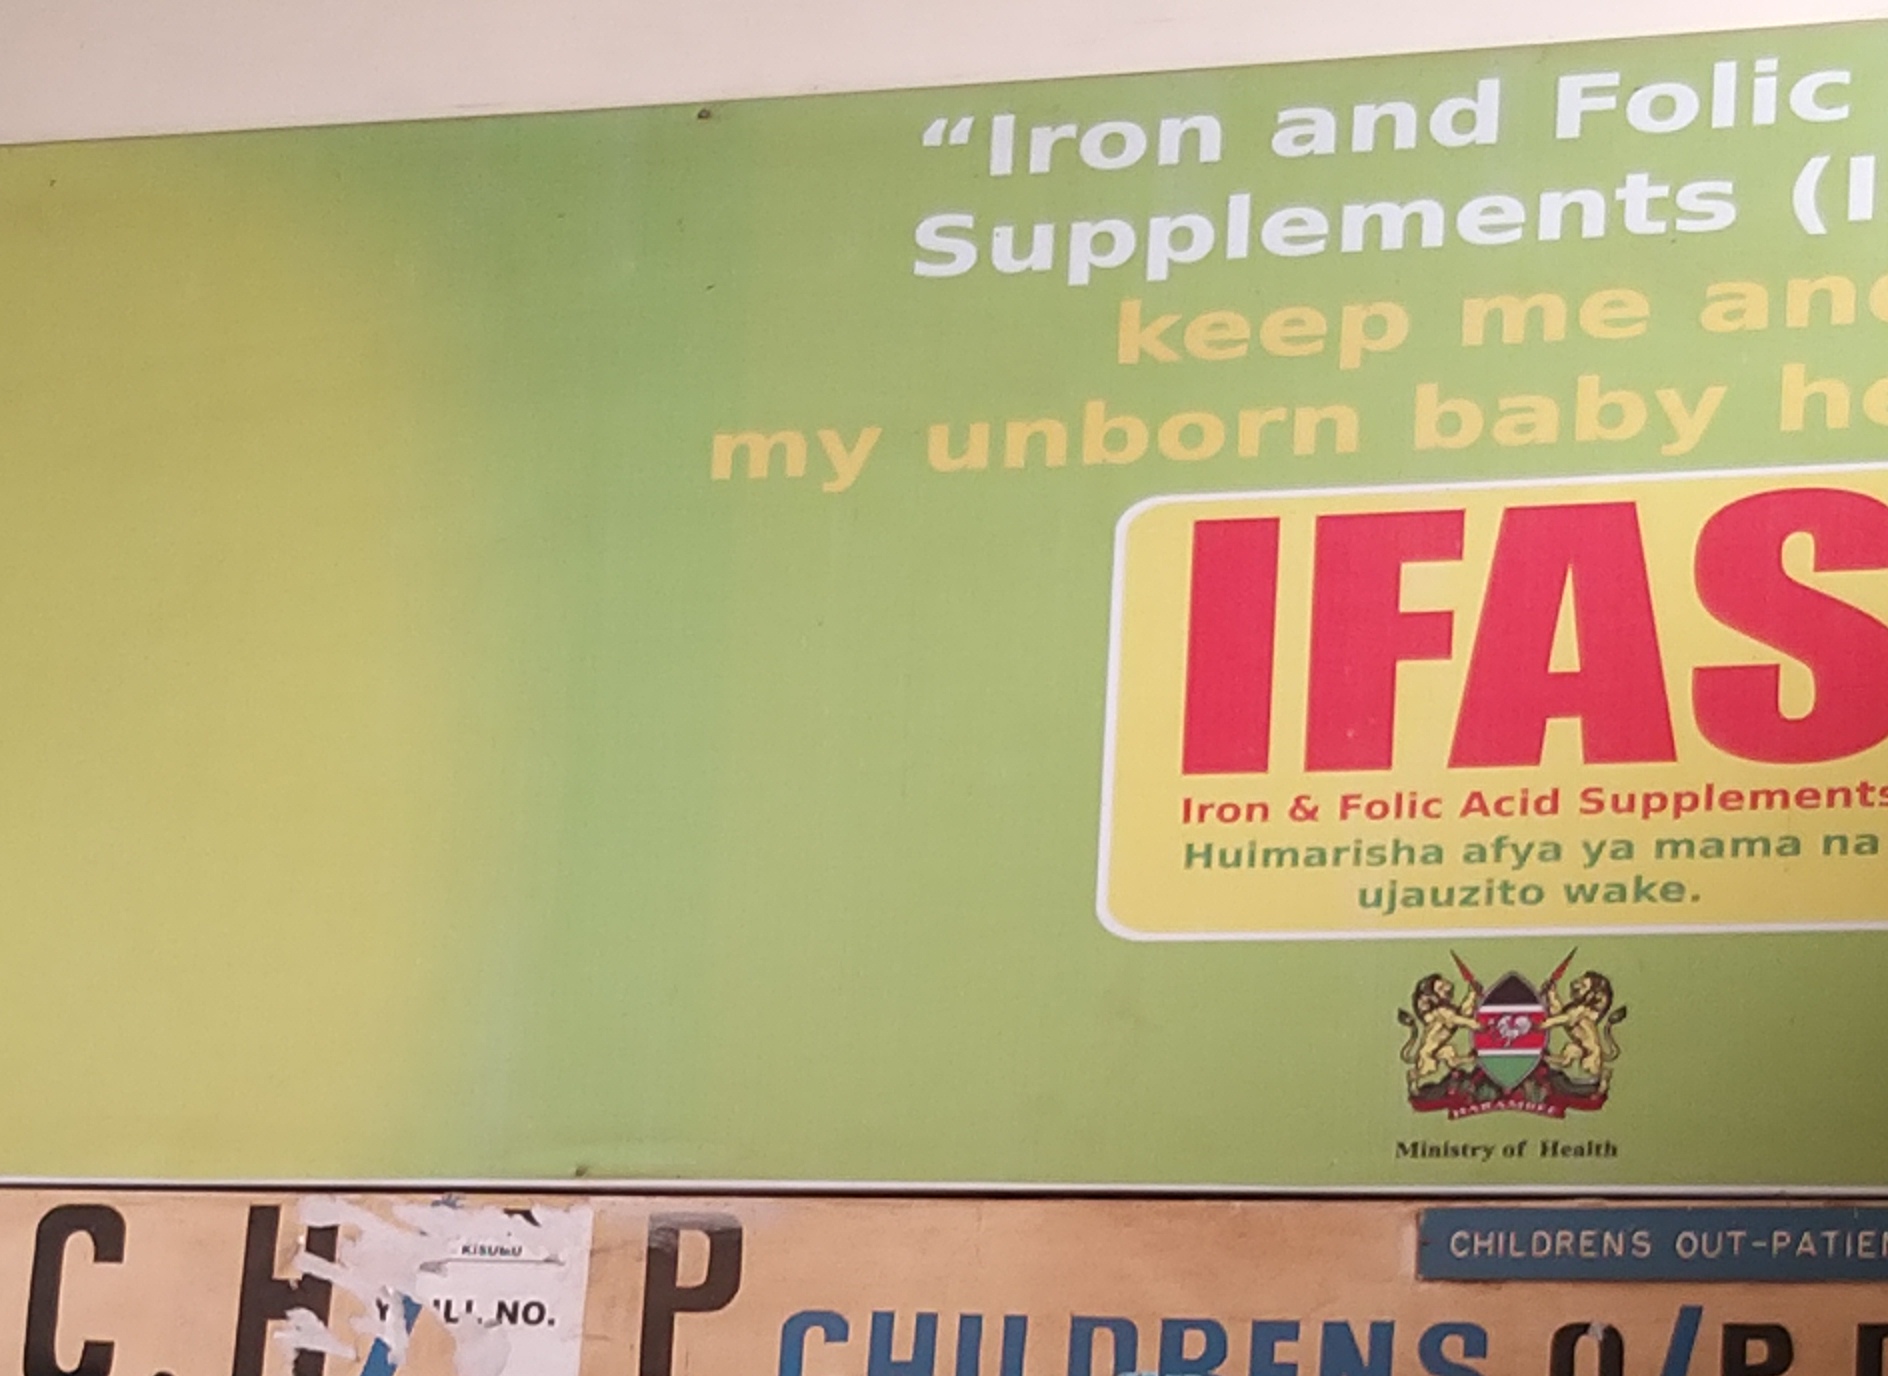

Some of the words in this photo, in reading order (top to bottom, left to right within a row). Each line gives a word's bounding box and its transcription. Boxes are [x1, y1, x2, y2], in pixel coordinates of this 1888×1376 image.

[1270, 76, 1505, 157] and
[1556, 51, 1853, 142] Folic
[912, 170, 1737, 285] Supplements
[1118, 294, 1409, 371] keep
[1461, 286, 1651, 346] me
[710, 423, 882, 494] my
[926, 398, 1359, 474] unborn
[1413, 374, 1728, 457] baby
[1180, 796, 1270, 825] Iron
[1288, 794, 1320, 823] &
[1339, 789, 1444, 821] Folic
[1459, 786, 1562, 818] Acid
[1184, 836, 1445, 870] Huimarisha
[1462, 833, 1564, 868] afya
[1583, 838, 1632, 868] ya
[1654, 833, 1803, 860] mama
[1822, 832, 1880, 858] na
[1358, 875, 1546, 914] ujauzito
[1564, 872, 1702, 906] wake.
[1395, 1140, 1495, 1161] Ministry
[1502, 1140, 1529, 1158] of
[1539, 1140, 1618, 1158] Health
[1449, 1230, 1652, 1259] CHILDRENS
[495, 1300, 555, 1327] NO.
